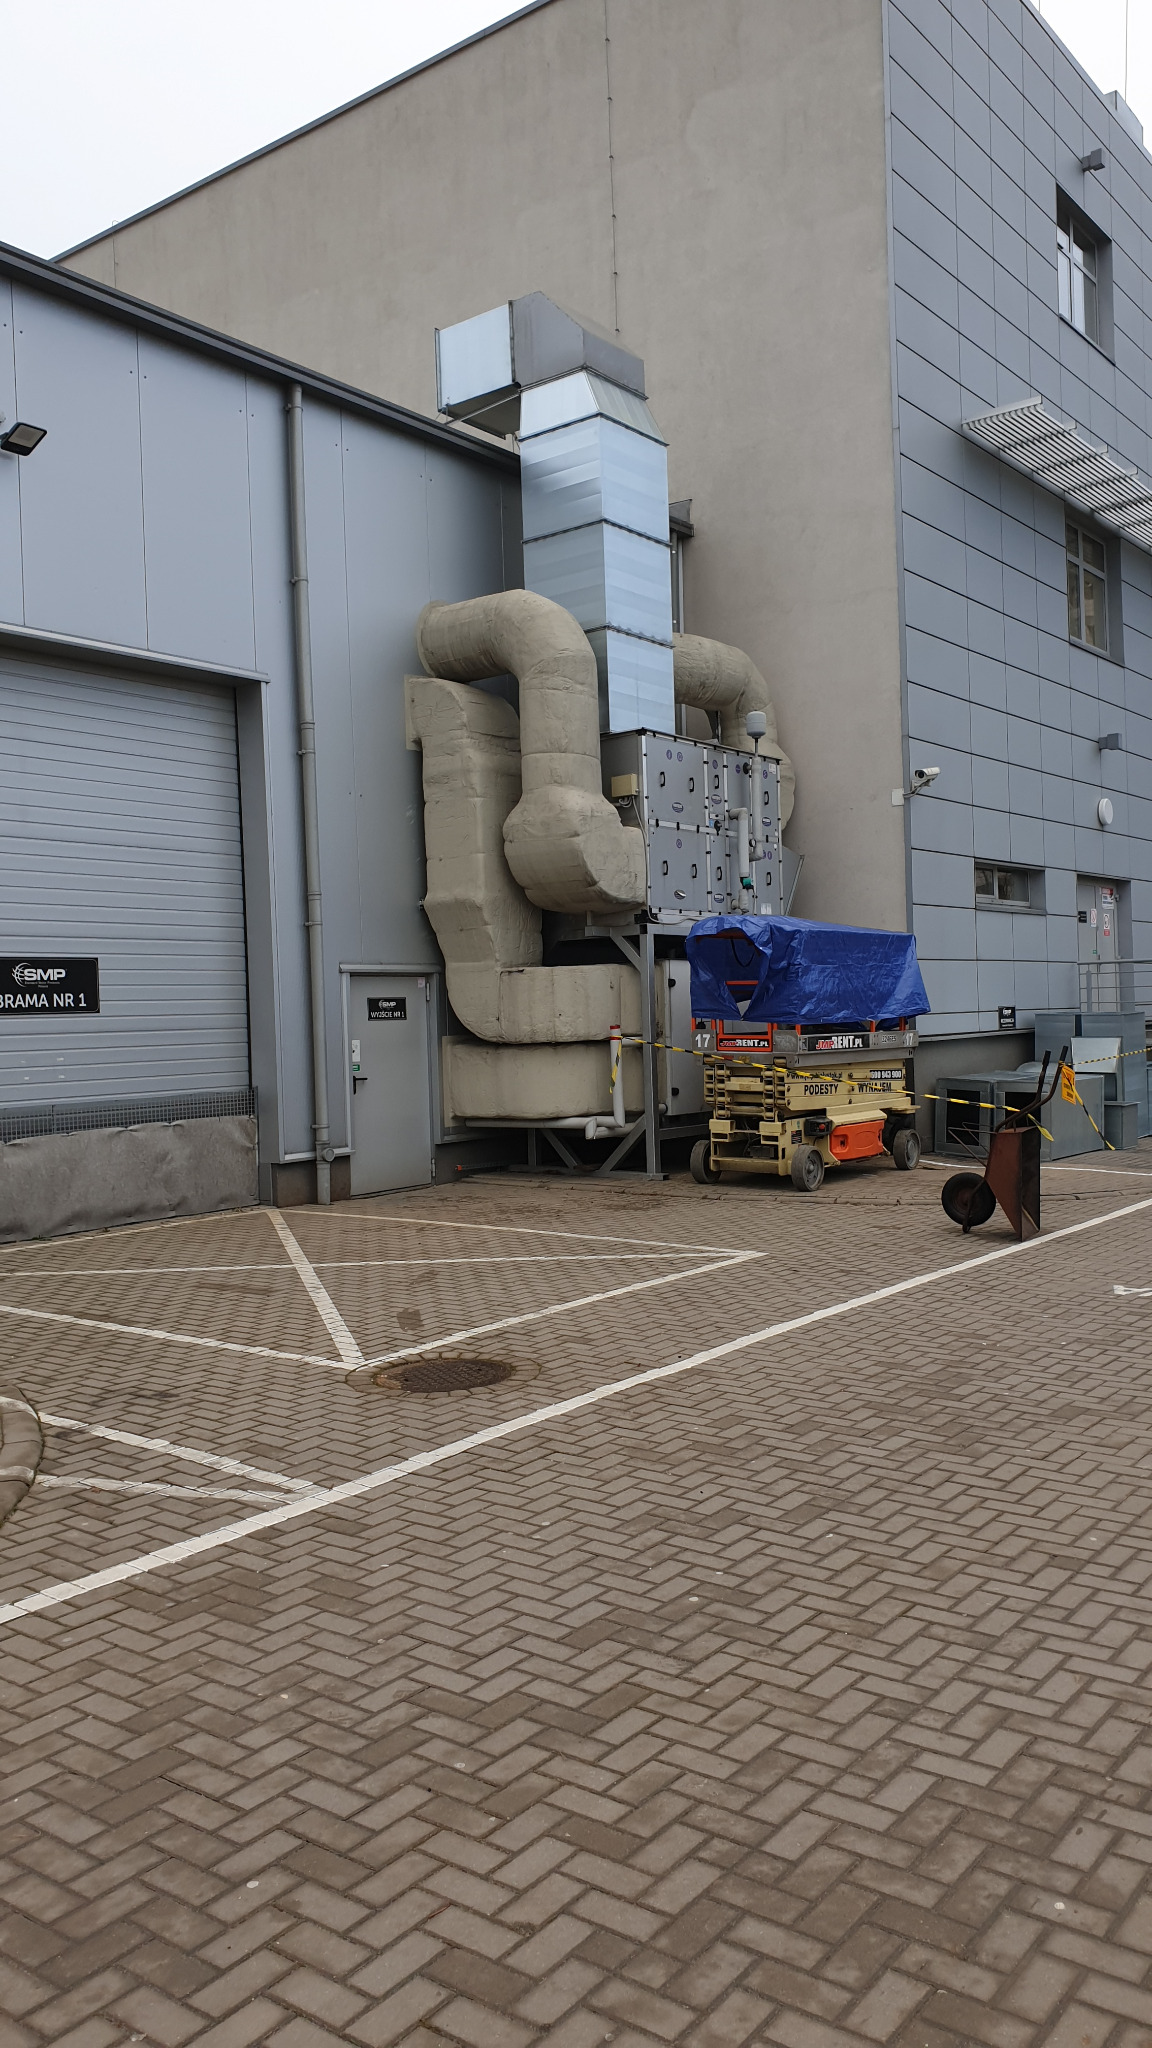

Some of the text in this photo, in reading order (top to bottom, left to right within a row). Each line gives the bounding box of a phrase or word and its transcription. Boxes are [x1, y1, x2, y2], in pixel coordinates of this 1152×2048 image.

[24, 968, 66, 981] SMP
[53, 993, 74, 1007] NR
[78, 992, 87, 1007] 1
[695, 1033, 711, 1048] 17
[804, 1081, 892, 1096] PODESTY WYNAJEM
